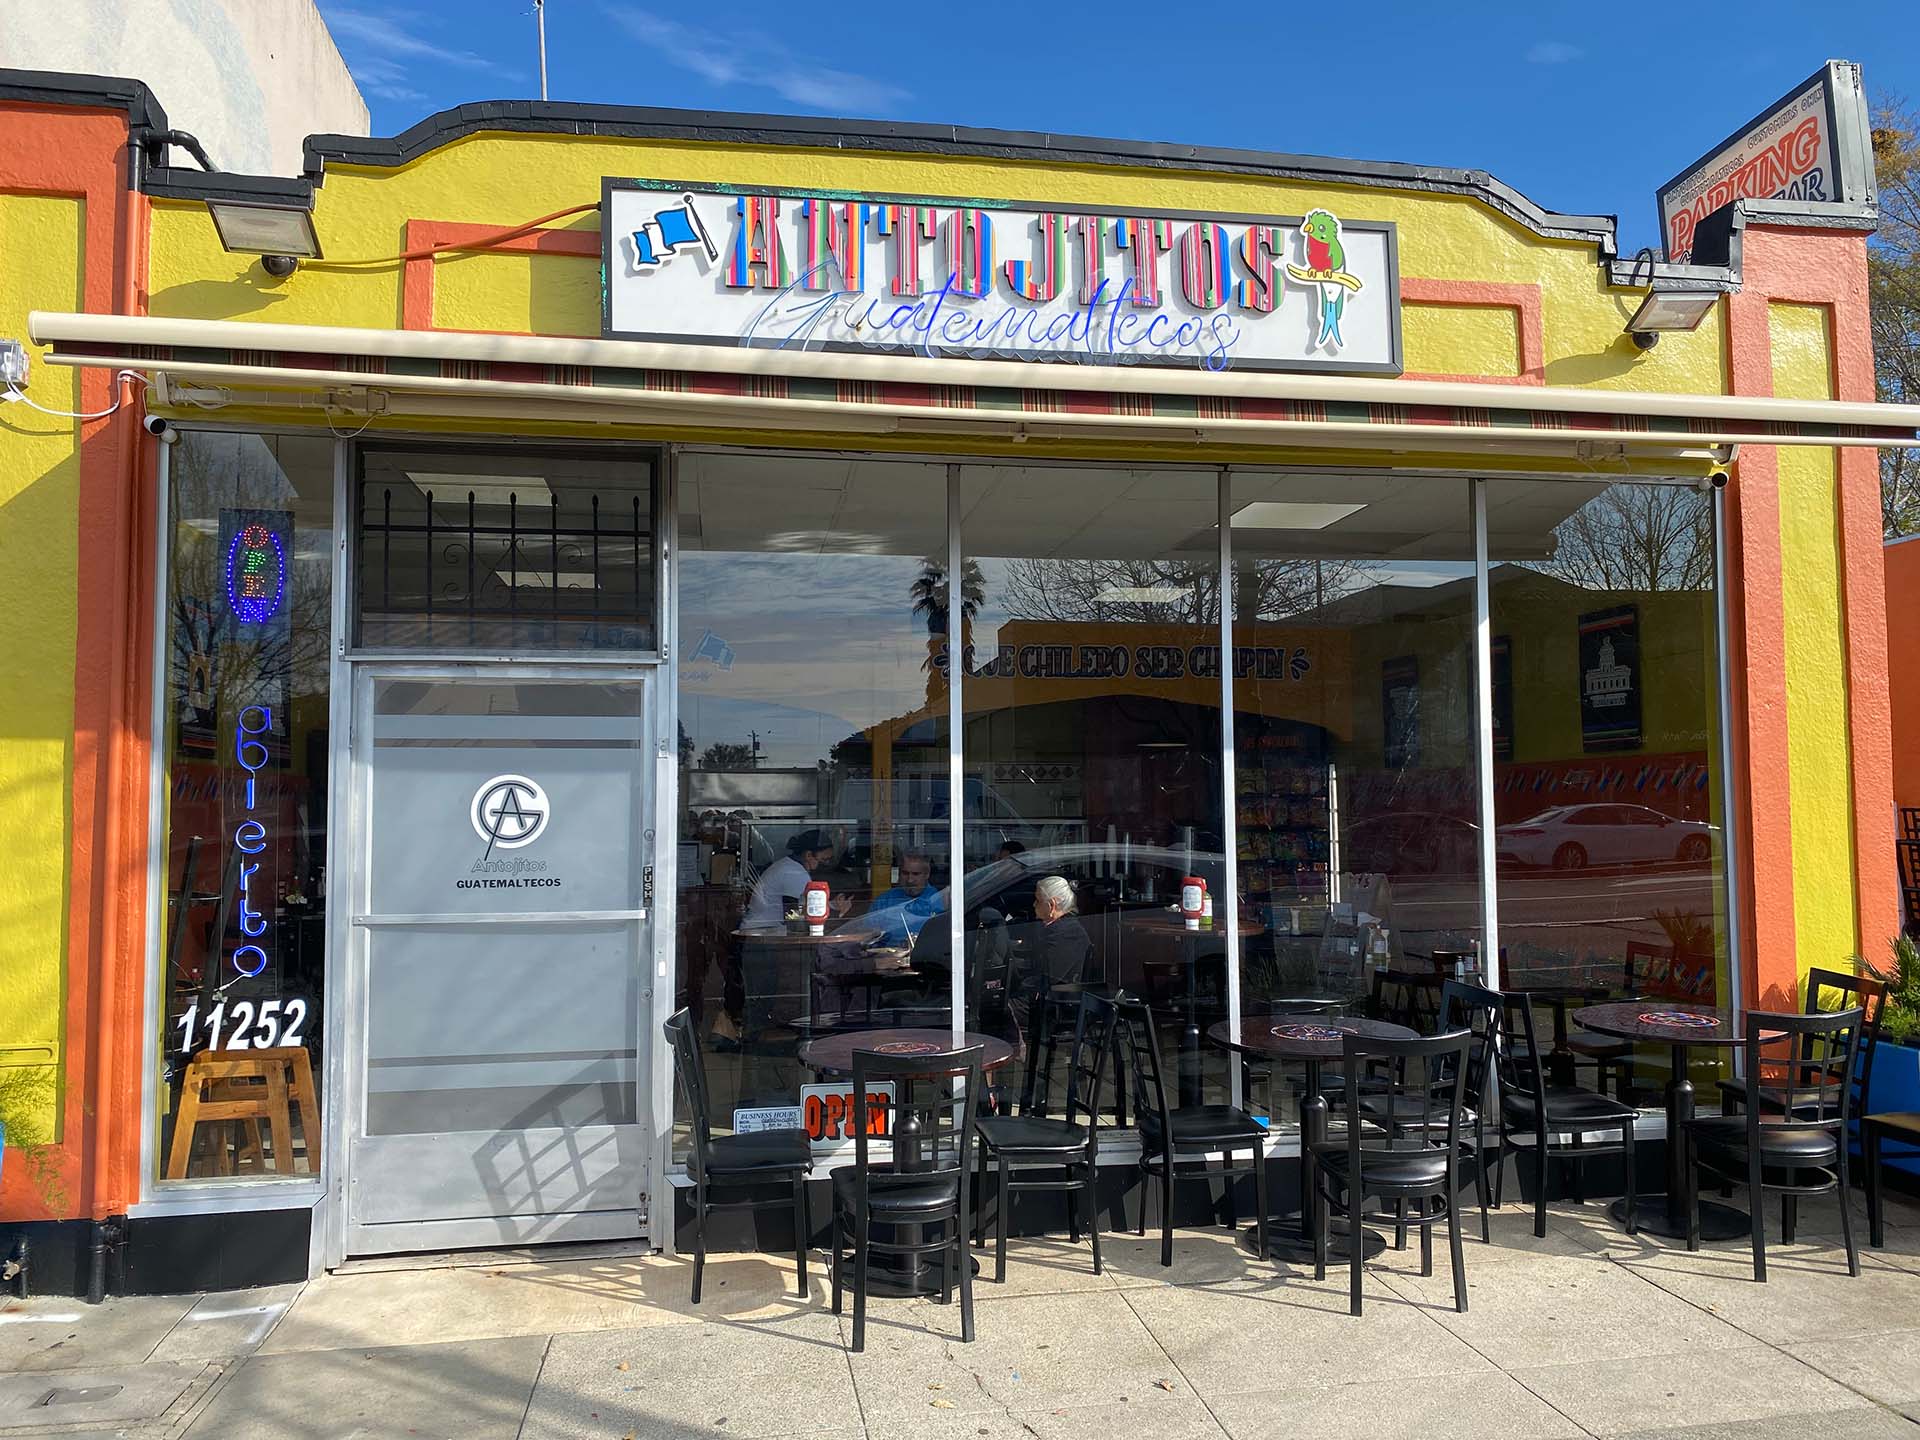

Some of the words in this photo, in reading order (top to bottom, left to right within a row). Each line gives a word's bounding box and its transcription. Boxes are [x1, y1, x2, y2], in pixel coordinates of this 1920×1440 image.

[1747, 104, 1799, 149] CUSTOMERS
[1800, 86, 1824, 112] ONLY
[1670, 116, 1821, 260] PARKING
[725, 196, 1286, 313] ANTOJITOS
[747, 258, 1241, 372] Guatemaltecos
[240, 522, 269, 624] OPEN
[1018, 644, 1131, 680] CHILERO
[1134, 644, 1186, 680] SER
[1188, 645, 1286, 681] CHPIN
[233, 705, 272, 978] abierto
[471, 857, 547, 876] Antojitos
[456, 878, 561, 889] GUATEMALTECOS
[176, 1000, 307, 1054] 11252
[740, 1112, 773, 1120] BUSINESS
[774, 1110, 797, 1119] HOURS
